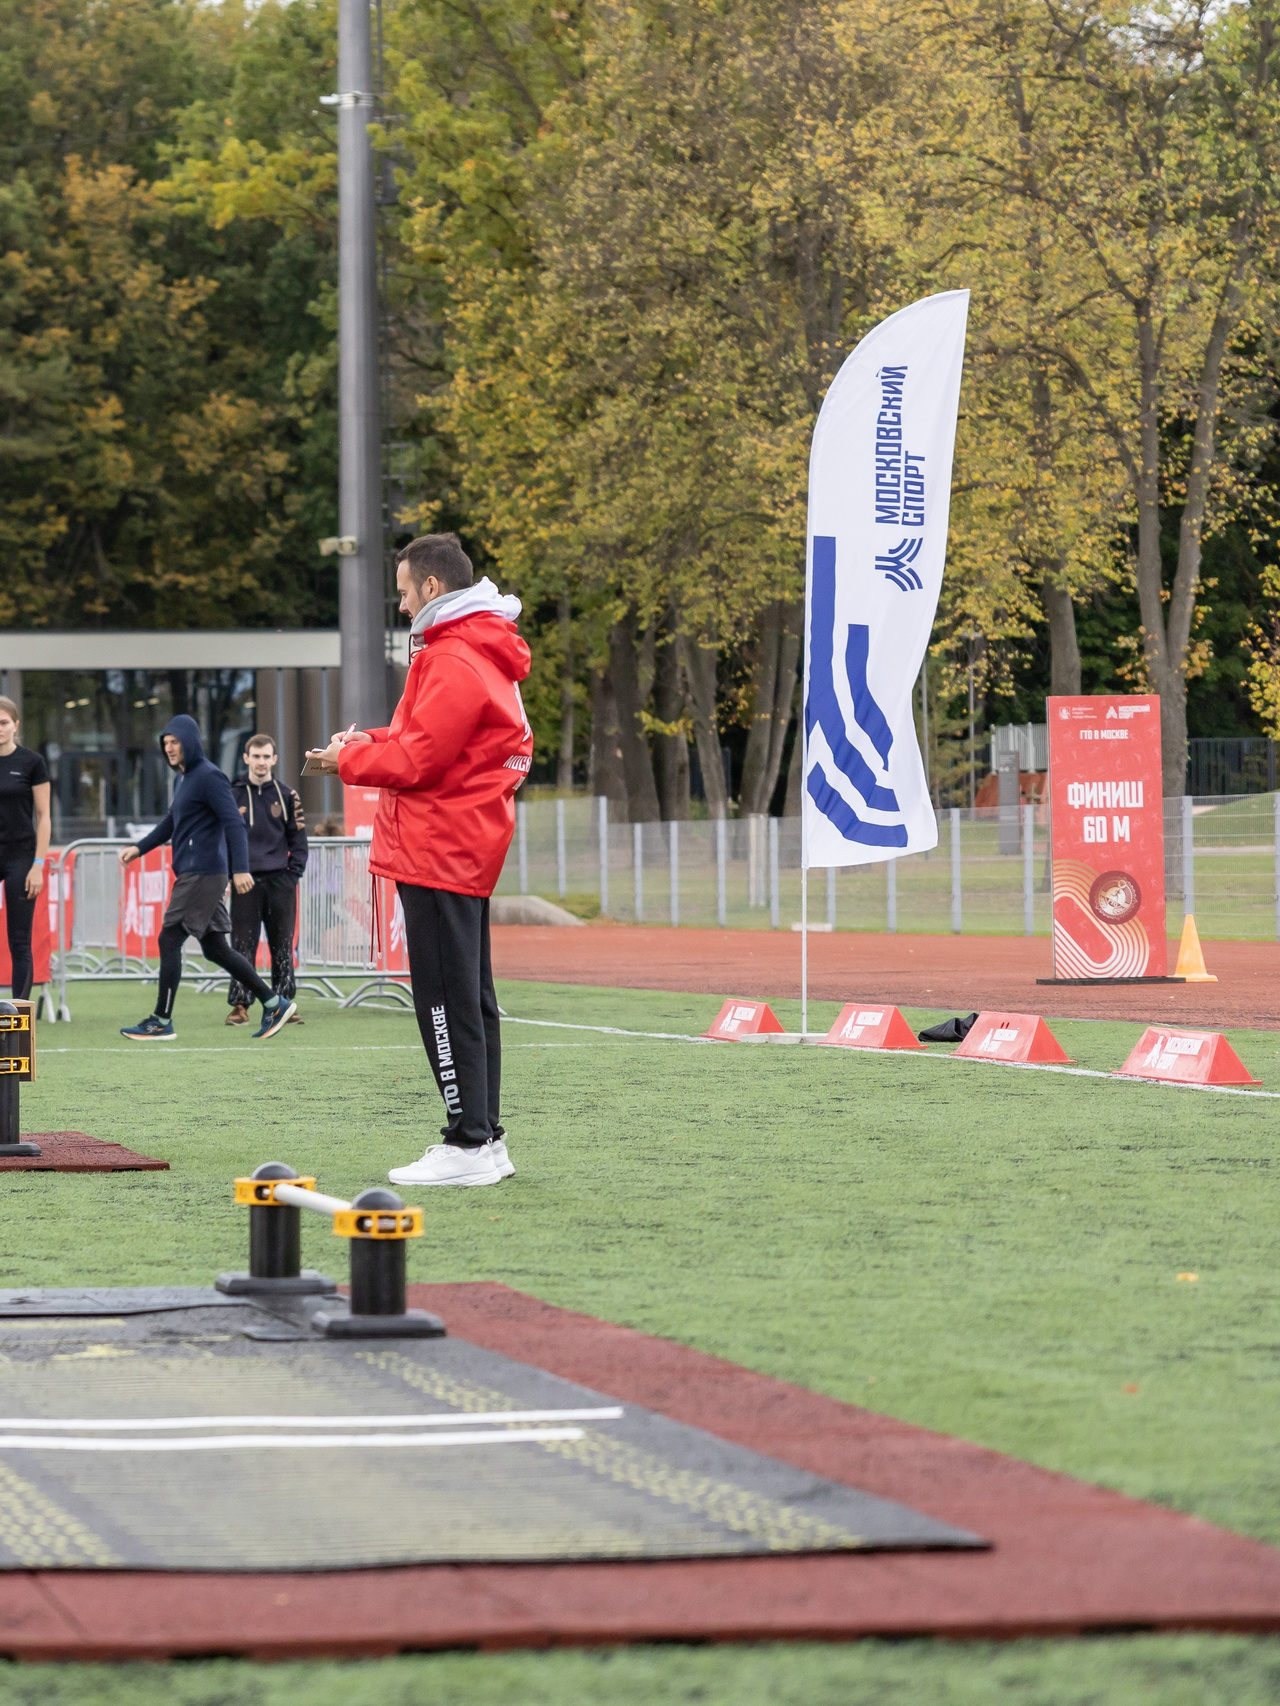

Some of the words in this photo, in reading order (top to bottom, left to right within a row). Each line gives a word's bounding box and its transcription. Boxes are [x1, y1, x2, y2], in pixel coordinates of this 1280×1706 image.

[875, 366, 908, 524] МОСКОВСКИЙ
[901, 450, 925, 527] СПОРТ
[1080, 729, 1092, 740] ГТО
[1094, 729, 1099, 740] В
[1101, 729, 1129, 740] МОСКВЕ
[1067, 781, 1144, 809] ФИНИШ
[1083, 815, 1108, 843] 60
[1113, 815, 1130, 842] М
[431, 1005, 454, 1067] МОСКВЕ
[440, 1068, 457, 1081] В
[443, 1083, 463, 1115] ГТО
